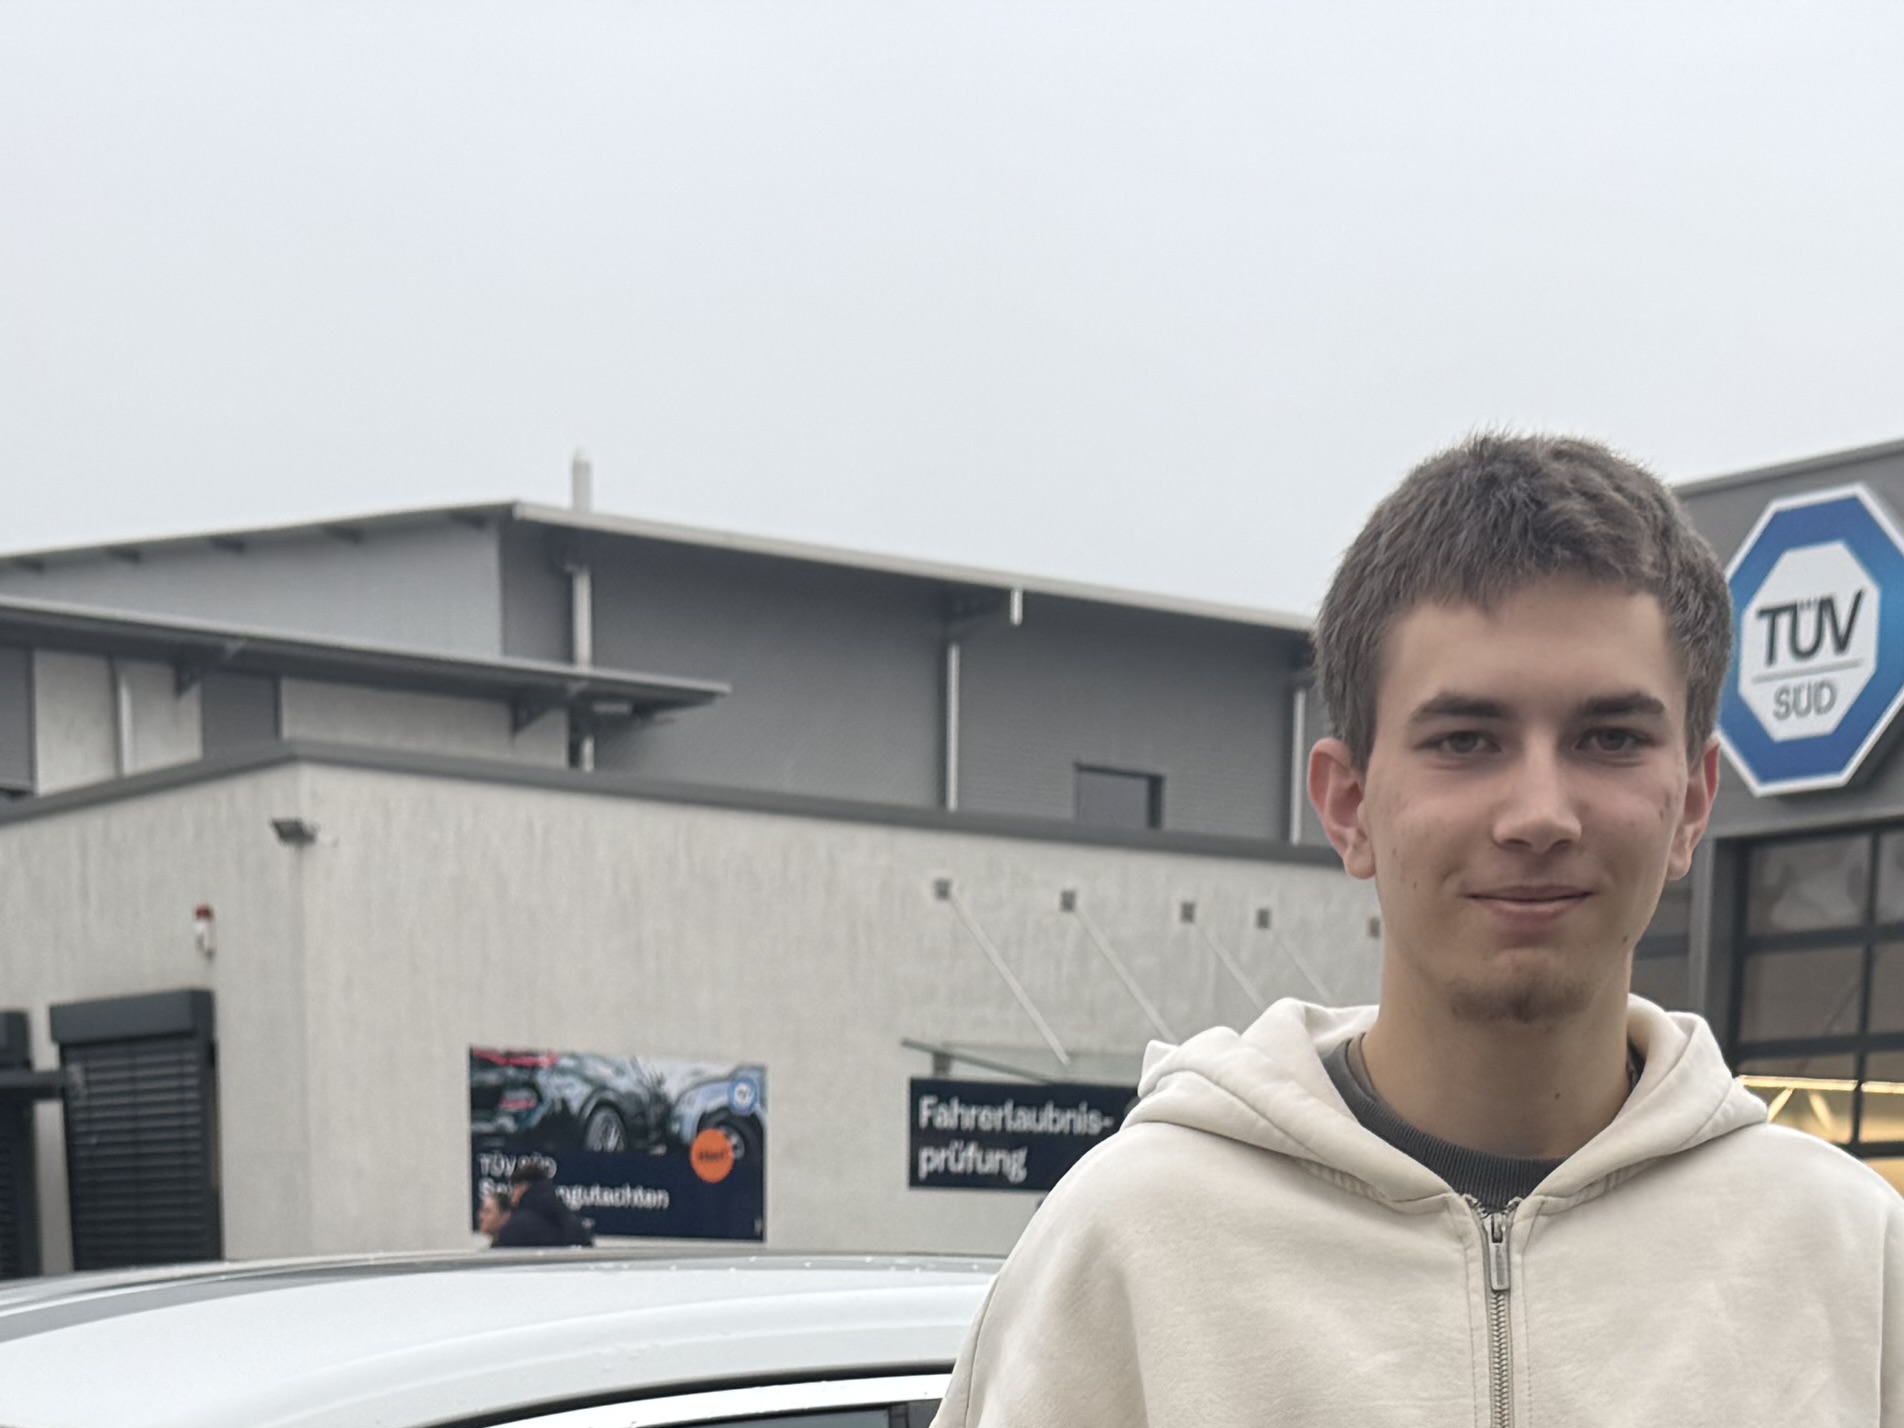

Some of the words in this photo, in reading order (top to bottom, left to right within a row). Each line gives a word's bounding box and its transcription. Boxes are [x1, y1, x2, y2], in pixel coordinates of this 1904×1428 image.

[1756, 587, 1864, 667] TÜV
[1773, 677, 1838, 722] SÜD
[918, 1095, 1115, 1135] Fahrerlaubnis-
[918, 1140, 1028, 1183] prüfung
